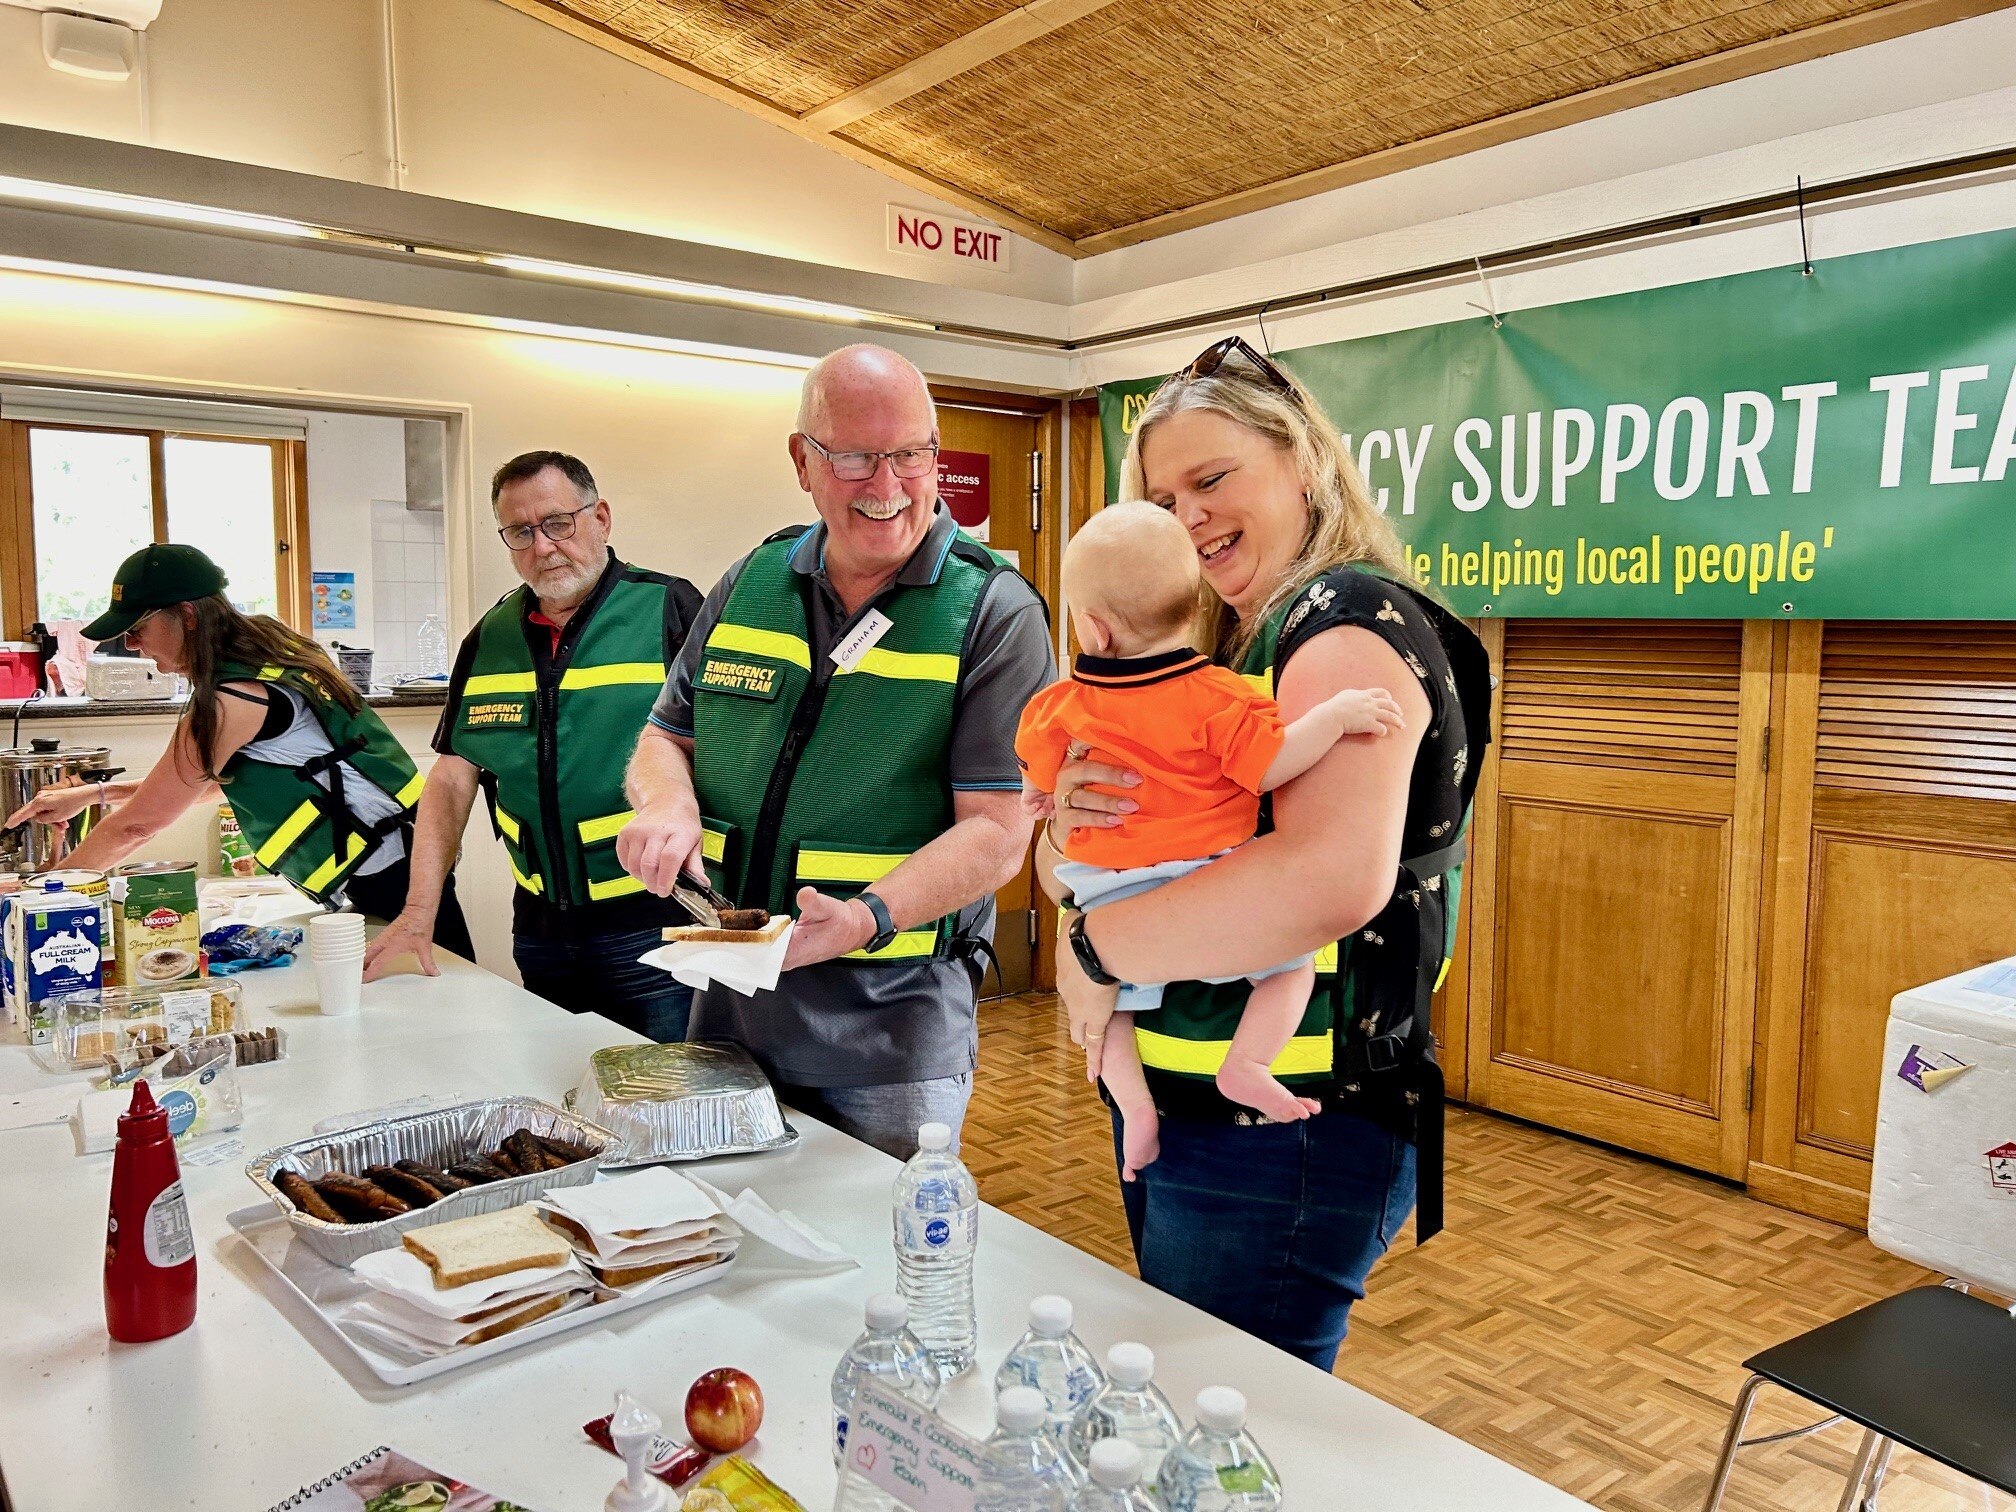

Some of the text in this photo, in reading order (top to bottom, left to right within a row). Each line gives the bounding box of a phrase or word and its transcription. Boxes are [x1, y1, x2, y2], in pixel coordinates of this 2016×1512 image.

[898, 214, 1002, 262] NO EXIT
[1451, 381, 1838, 512] SUPPORT
[946, 474, 980, 486] access
[1441, 538, 1564, 596] helping
[1577, 534, 1660, 584] local
[1674, 526, 1834, 594] people'
[841, 620, 879, 662] GRAHAM
[705, 660, 776, 680] EMERGENCY
[702, 671, 773, 694] SUPPORT TEAM
[468, 713, 522, 724] SUPPORT TEAM
[469, 703, 524, 715] EMERGENCY
[144, 914, 180, 925] MOCCONA
[39, 947, 91, 959] FULL CREAM
[55, 956, 76, 964] MILK
[889, 1455, 927, 1495] Team
